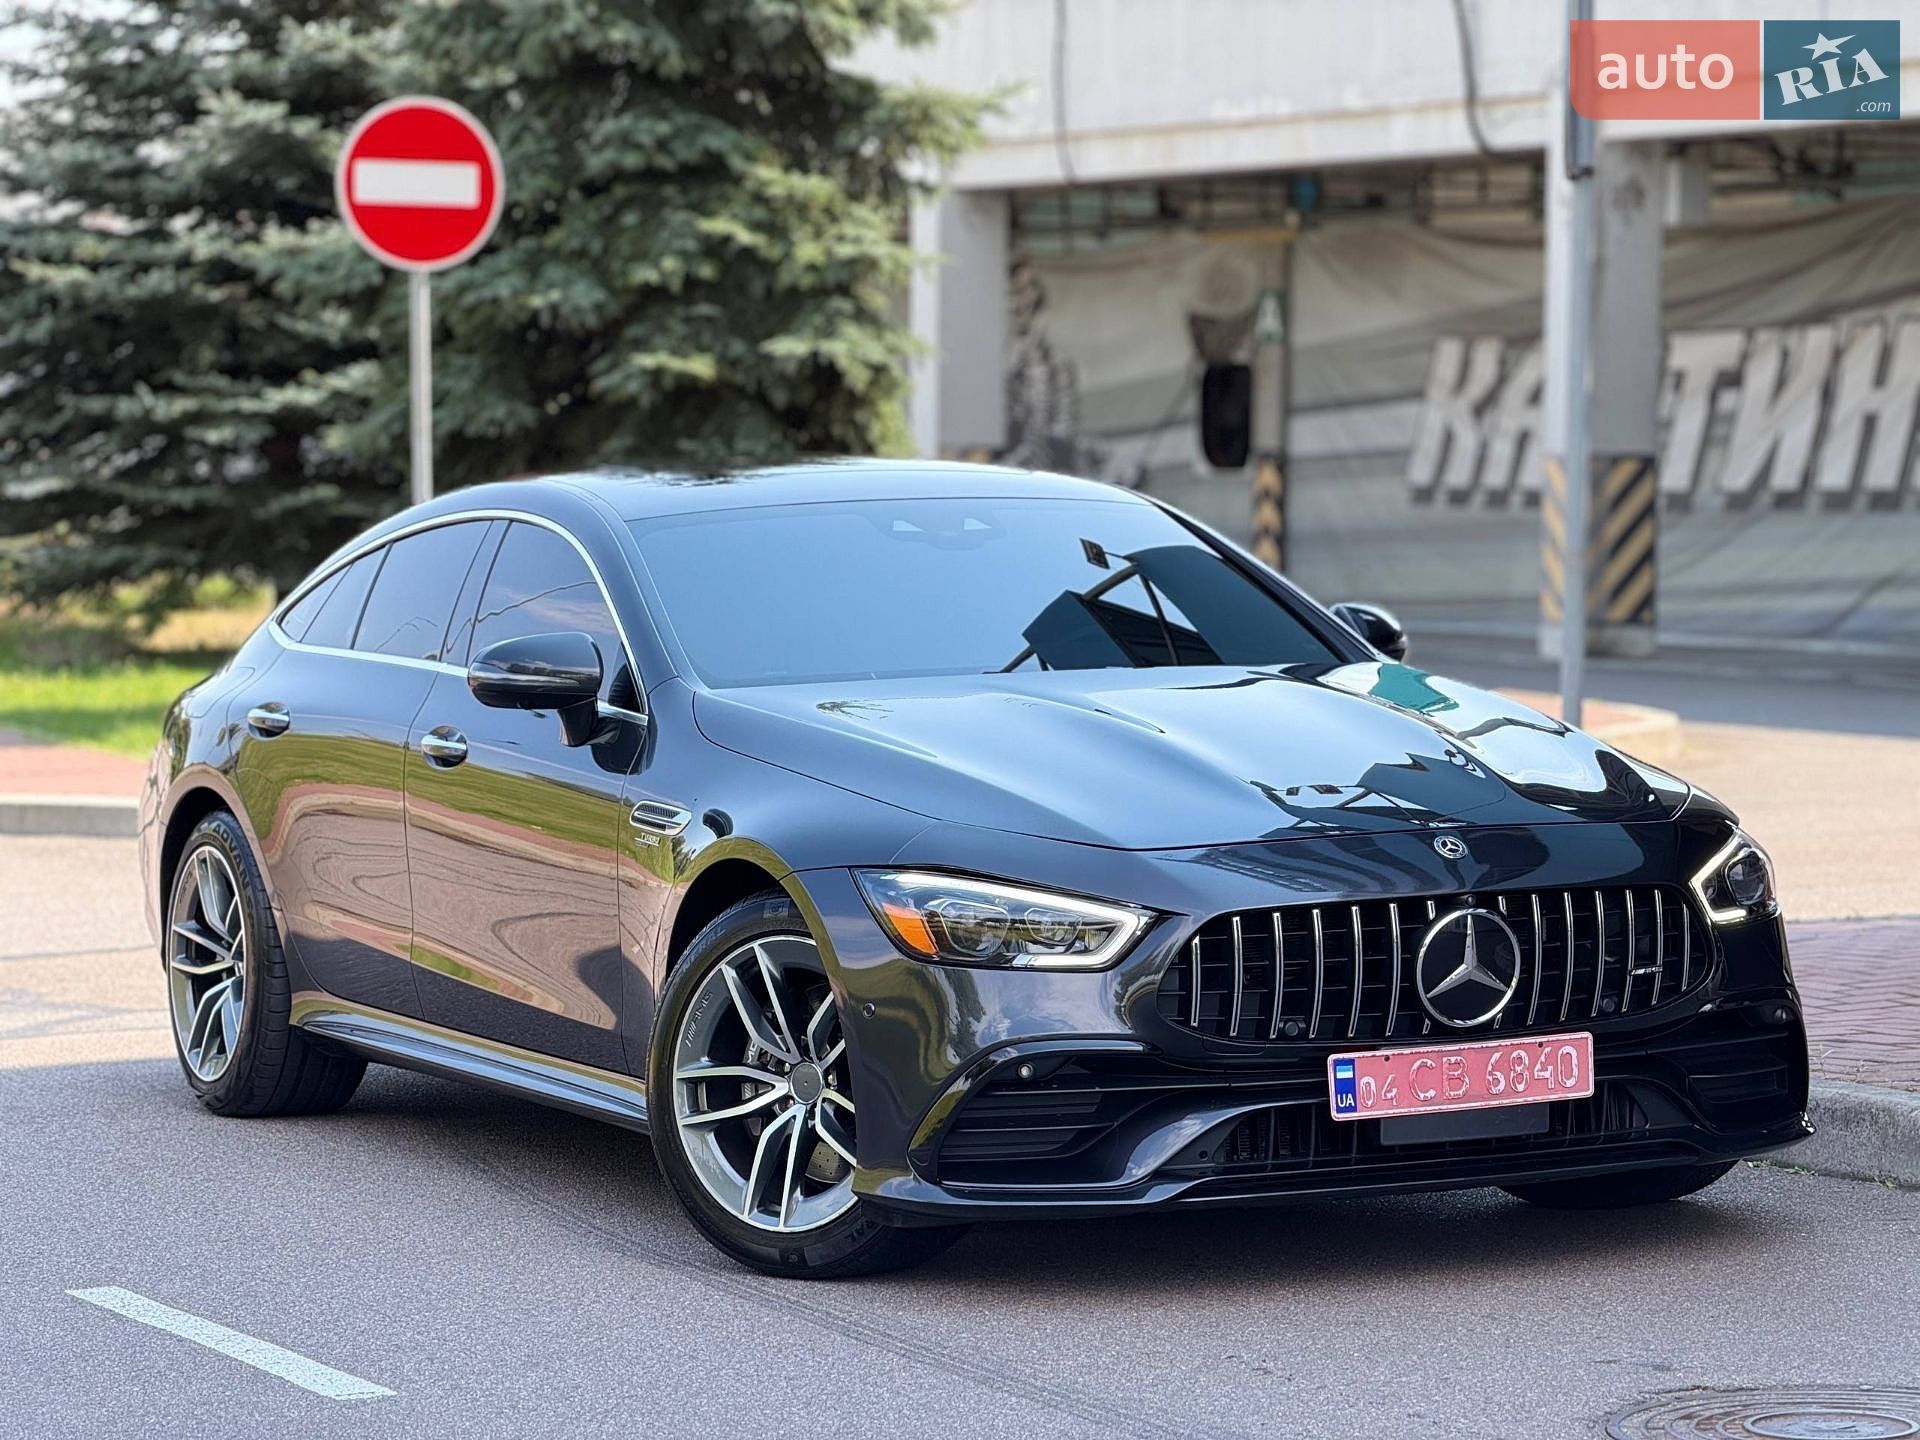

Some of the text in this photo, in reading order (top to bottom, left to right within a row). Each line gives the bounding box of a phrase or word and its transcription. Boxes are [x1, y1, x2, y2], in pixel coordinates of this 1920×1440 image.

[1359, 1045, 1578, 1108] 04 CB 6840
[1337, 1093, 1355, 1108] UA
